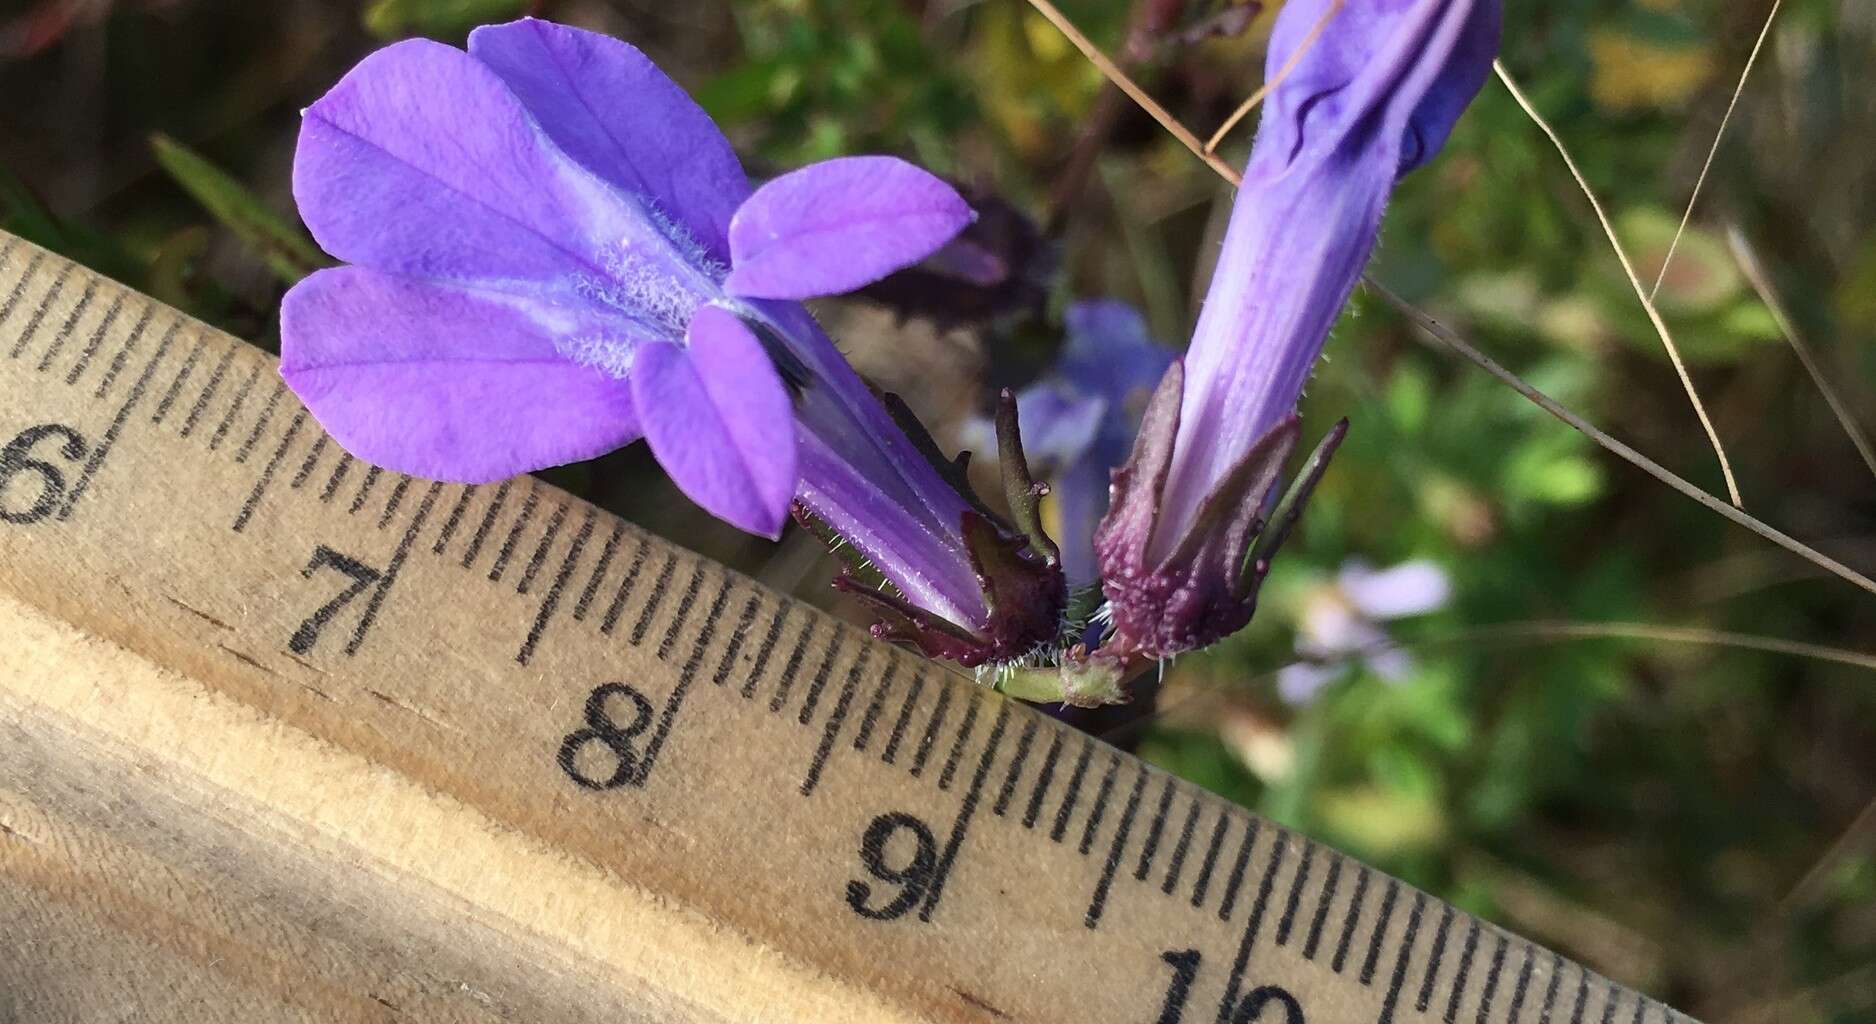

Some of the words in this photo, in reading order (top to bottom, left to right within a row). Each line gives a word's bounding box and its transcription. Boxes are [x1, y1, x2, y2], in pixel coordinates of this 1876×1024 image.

[0, 423, 87, 526] 6
[289, 544, 382, 654] 7
[557, 682, 654, 791] 8
[845, 812, 937, 921] 9
